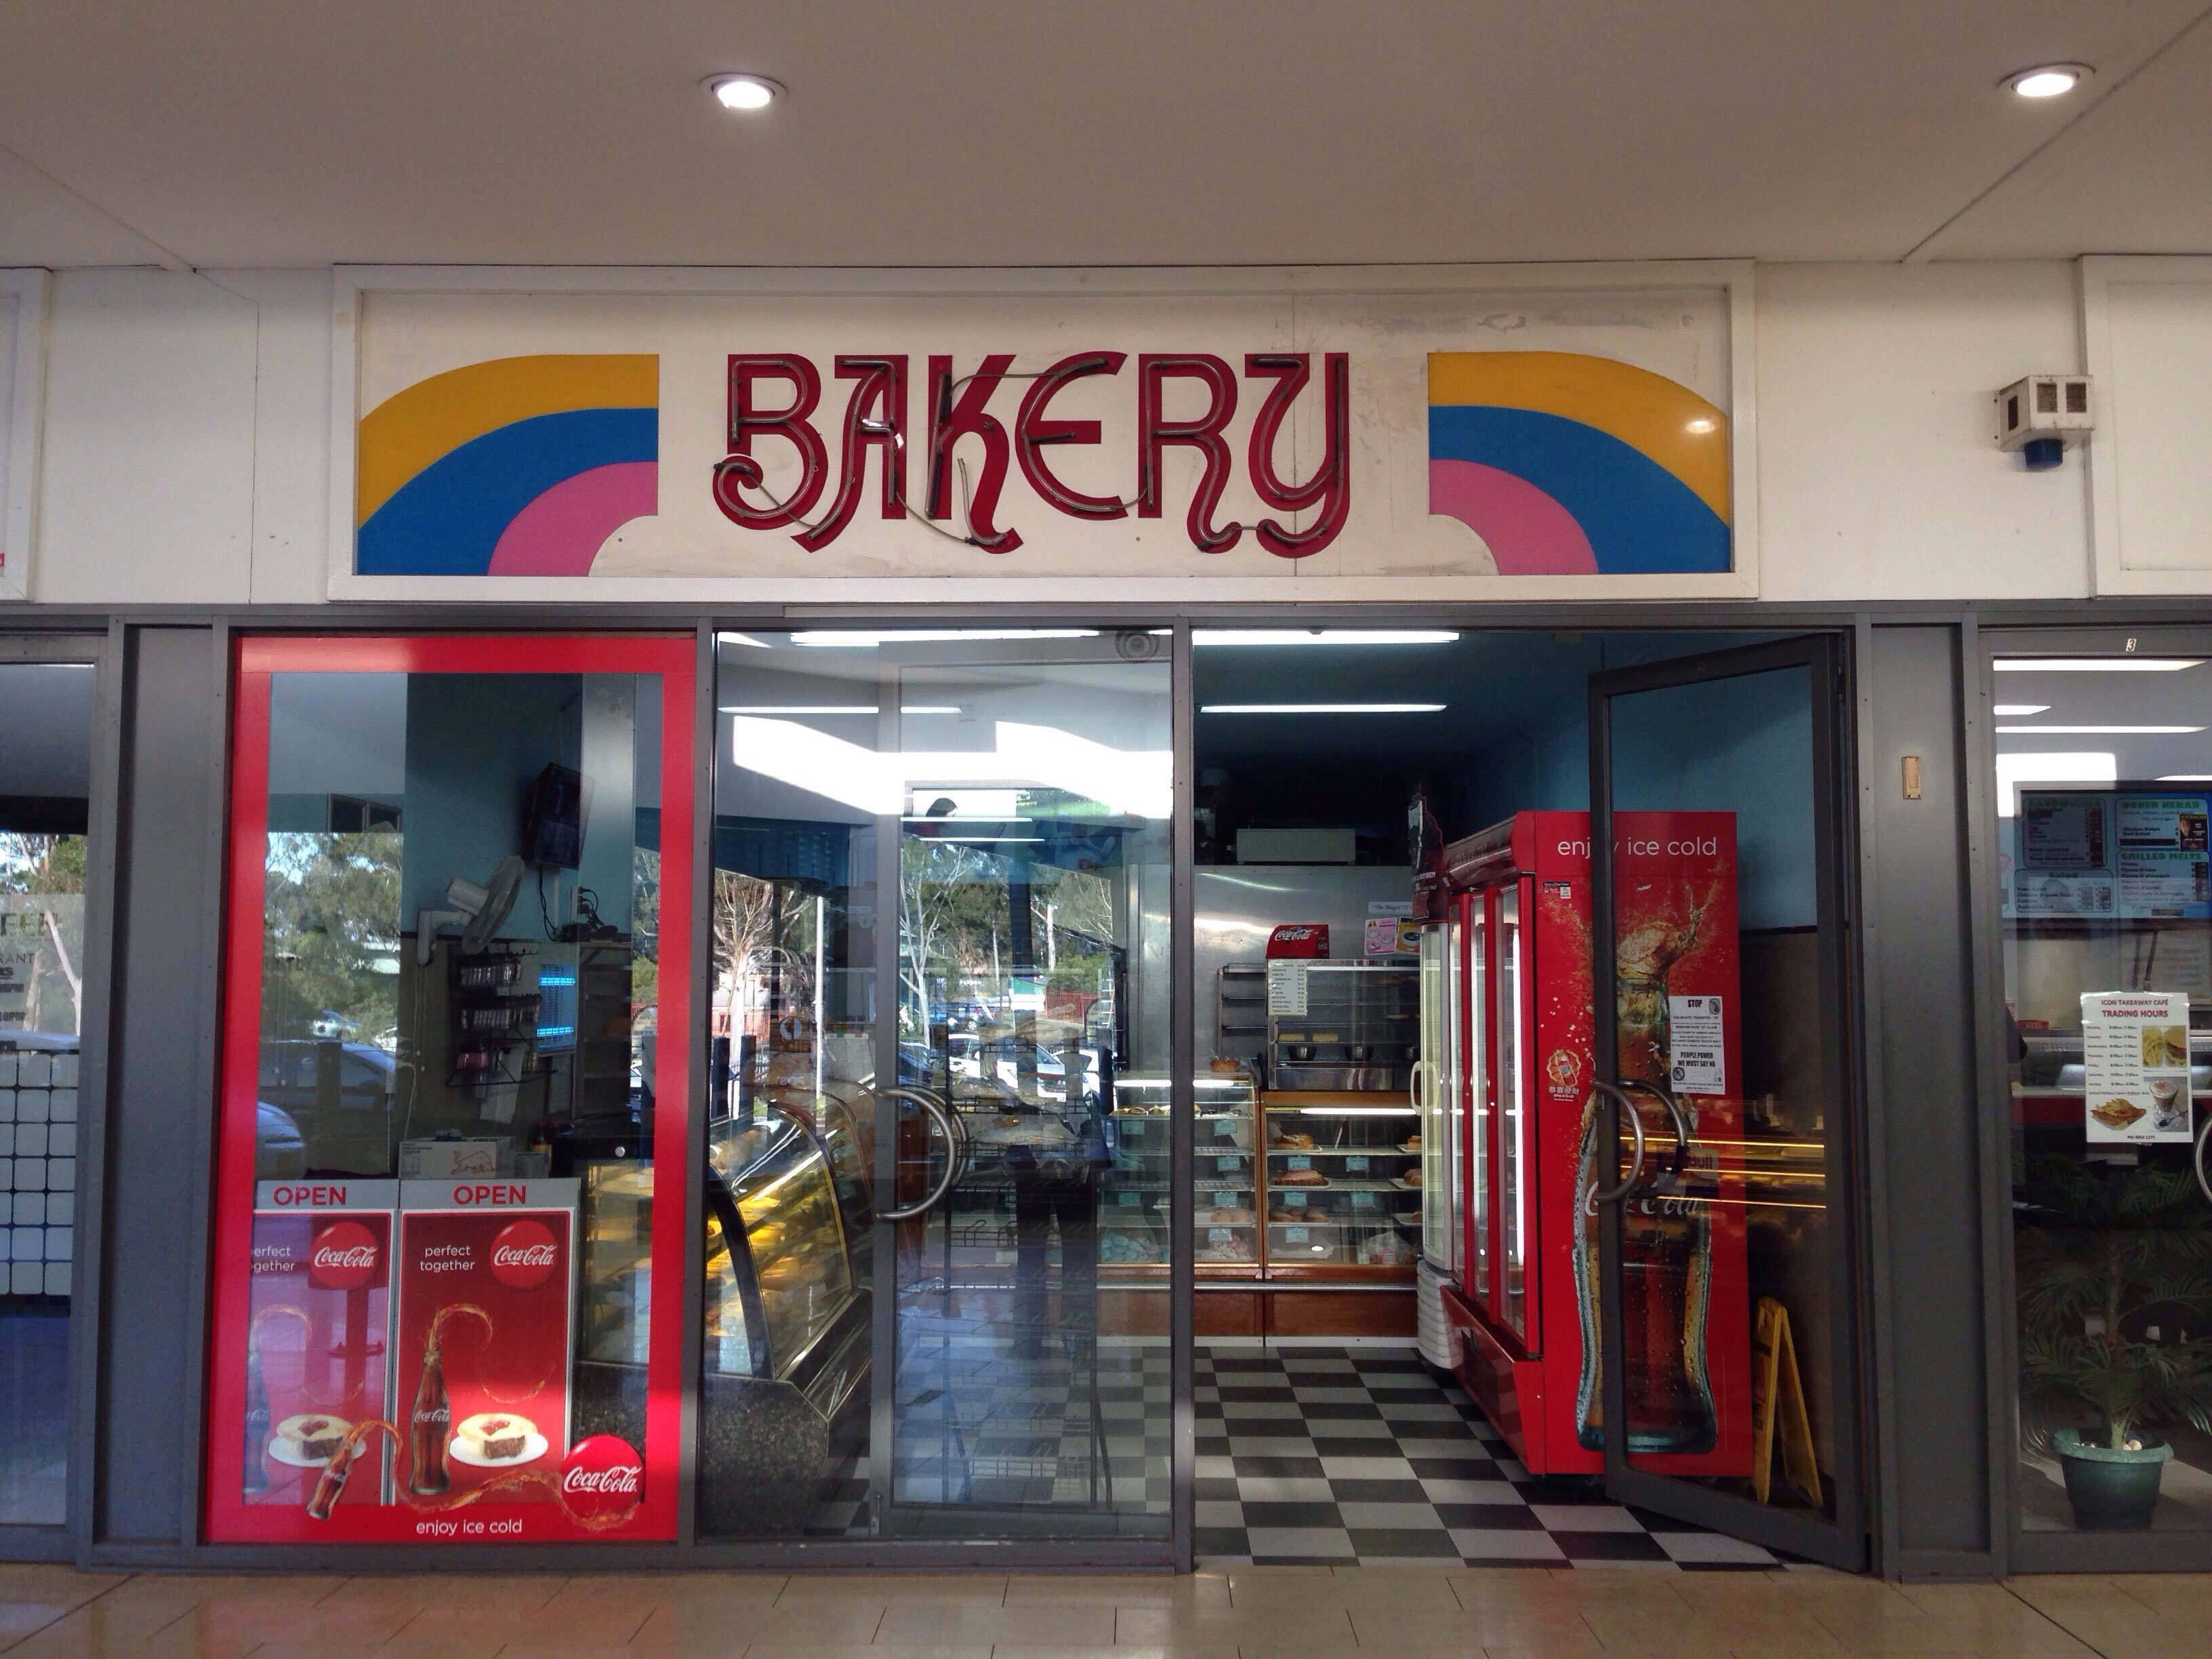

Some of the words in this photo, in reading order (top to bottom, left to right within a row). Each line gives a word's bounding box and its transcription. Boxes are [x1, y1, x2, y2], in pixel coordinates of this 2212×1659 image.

[712, 350, 1349, 558] BAKERY
[1628, 837, 1660, 855] ice
[1667, 836, 1717, 855] cold
[1687, 1000, 1702, 1008] STOP
[273, 1186, 347, 1206] OPEN
[453, 1185, 527, 1205] OPEN
[251, 1246, 291, 1257] erfect
[314, 1246, 378, 1268] Coca-Cola
[425, 1245, 471, 1258] perfect
[493, 1245, 557, 1267] Coca-Cola
[251, 1260, 295, 1273] gether
[419, 1260, 475, 1273] together
[564, 1466, 642, 1494] Coca-Cola
[415, 1519, 457, 1536] enjoy
[463, 1519, 485, 1534] ice
[489, 1518, 523, 1534] cold
